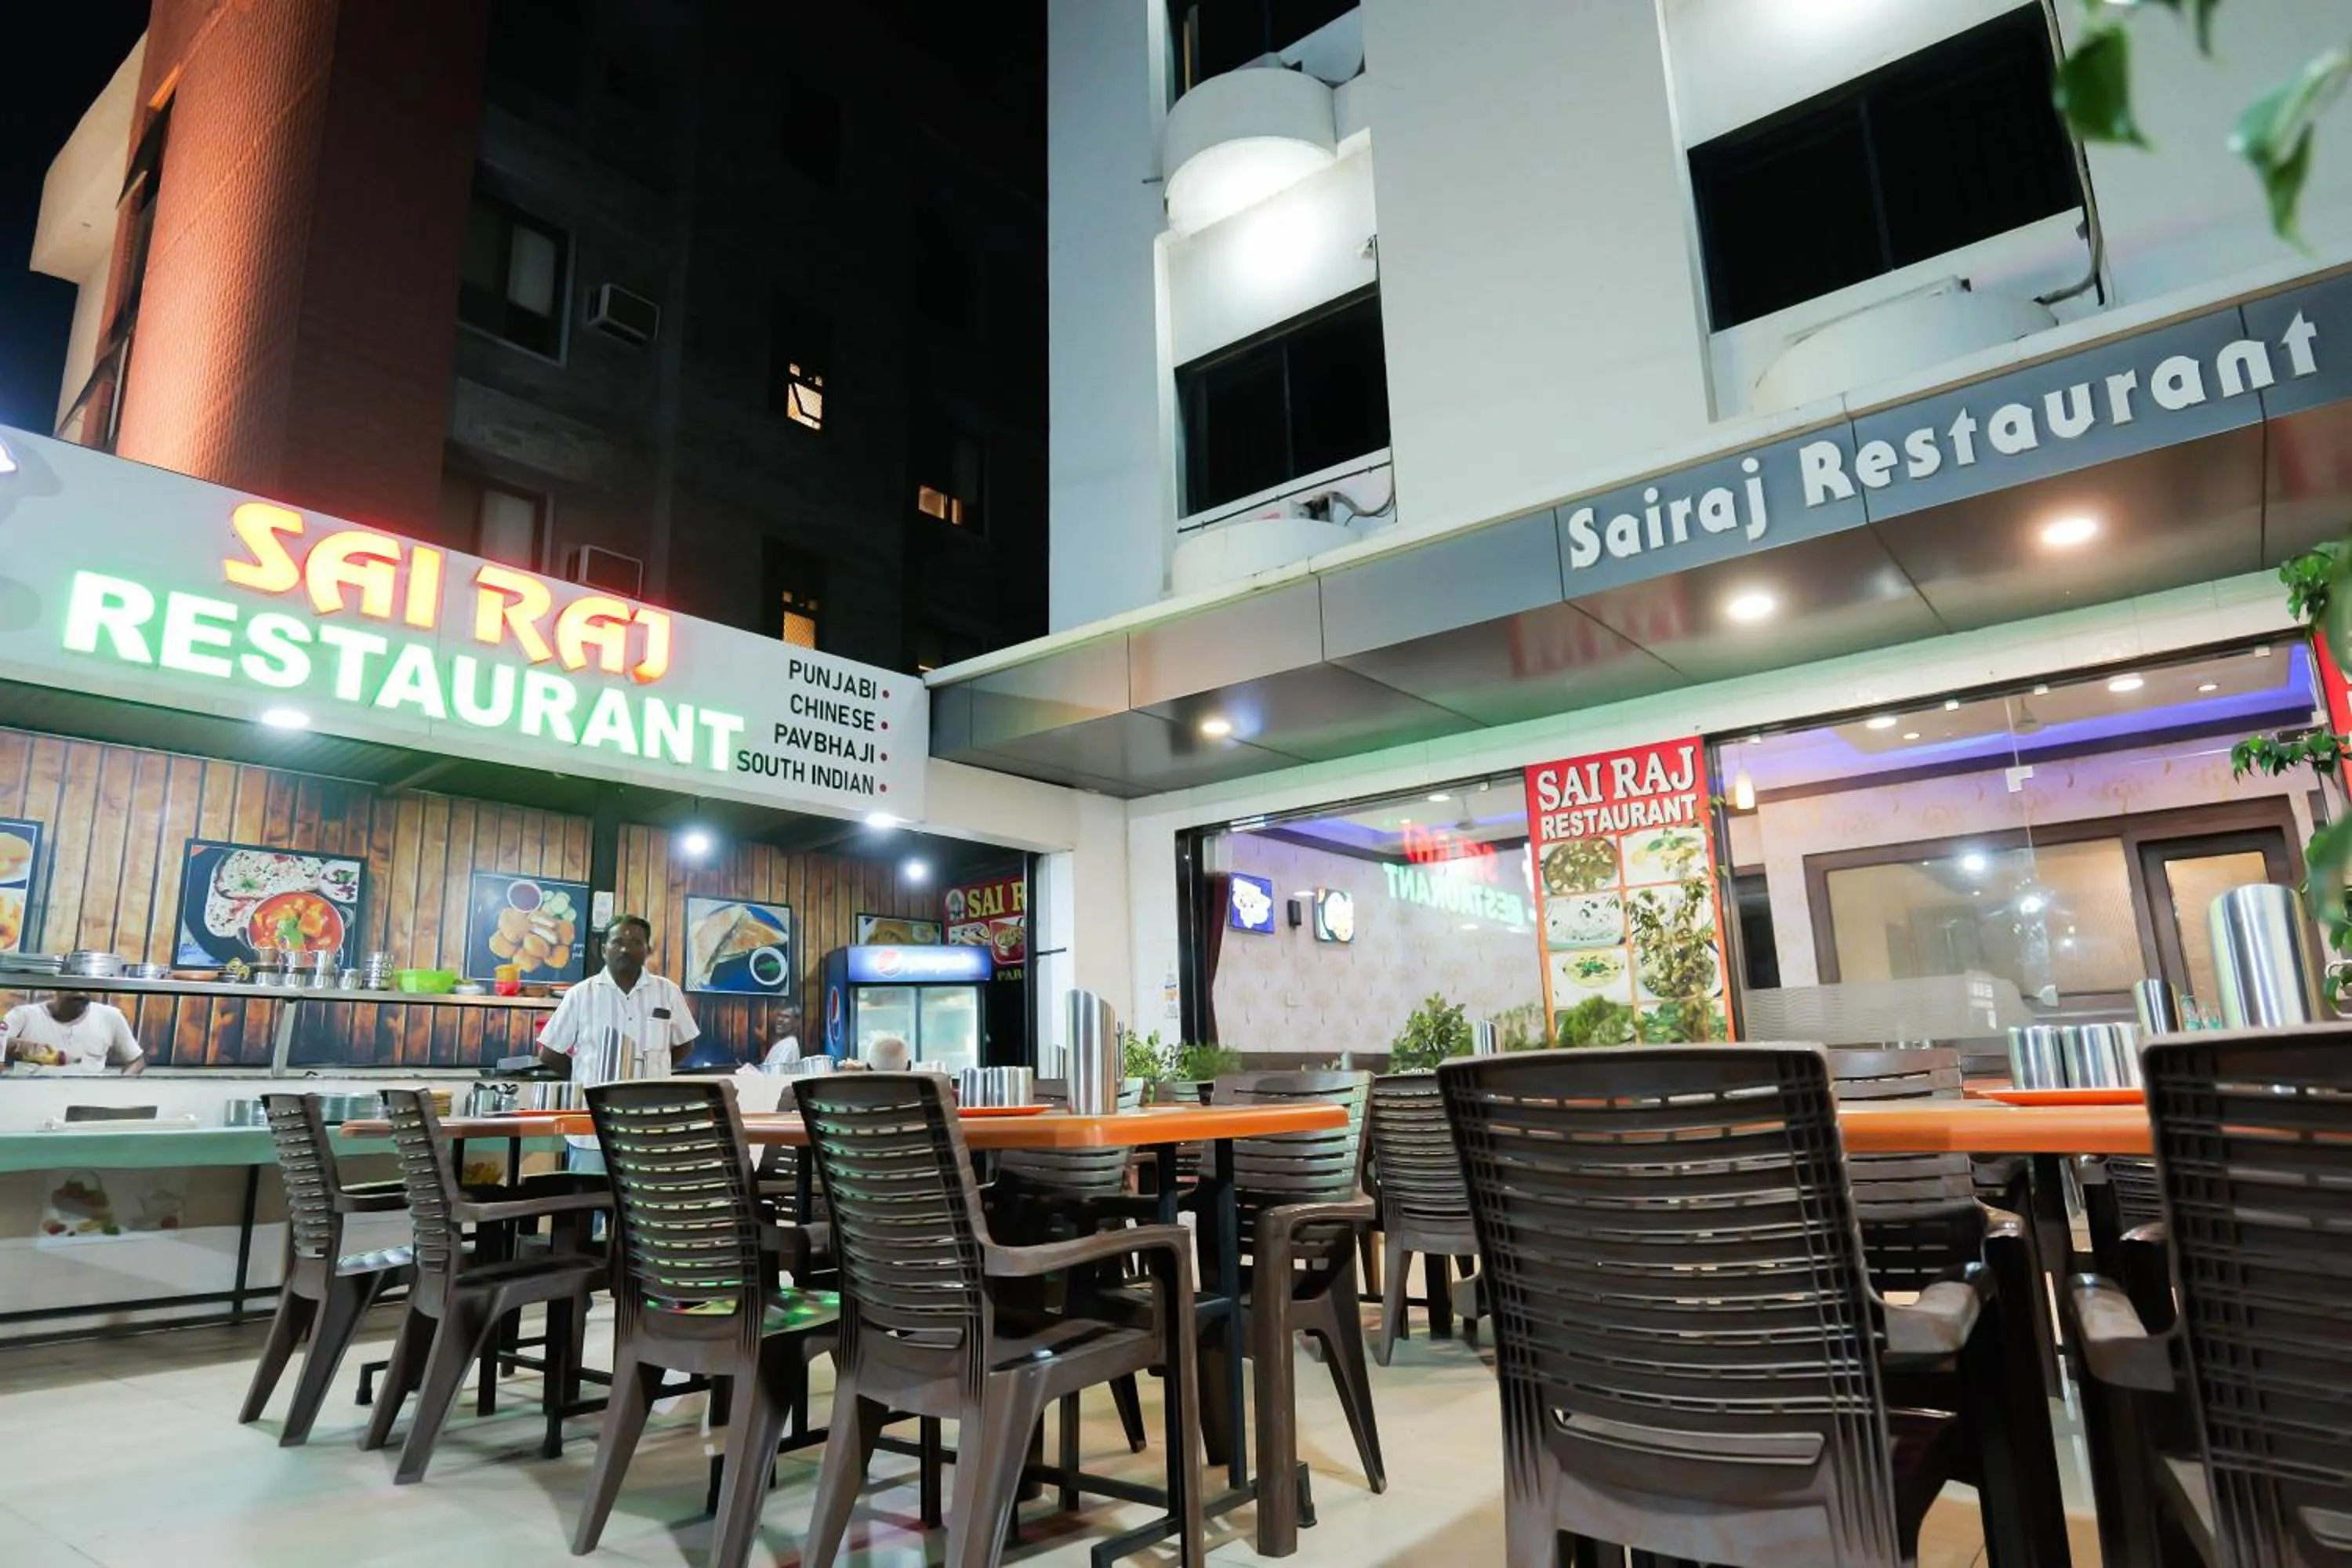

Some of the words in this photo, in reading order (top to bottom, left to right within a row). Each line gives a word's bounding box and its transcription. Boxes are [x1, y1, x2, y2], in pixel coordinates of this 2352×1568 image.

[1569, 456, 1767, 570] Sairaj
[1799, 309, 2318, 509] Restaurant
[223, 501, 443, 629] SAI
[474, 564, 672, 684] RAJ
[63, 570, 745, 771] RESTAURANT
[789, 659, 877, 700] PUNJABI
[790, 695, 876, 731] CHINESE
[774, 724, 875, 764] PAVBHAJI
[737, 750, 805, 782] SOUTH
[811, 764, 874, 795] INDIAN
[1537, 761, 1604, 813] SAI
[1610, 746, 1695, 800] RAJ
[1540, 793, 1698, 840] RESTAURANT
[967, 884, 1005, 918] SAI
[996, 969, 1025, 982] PAR
